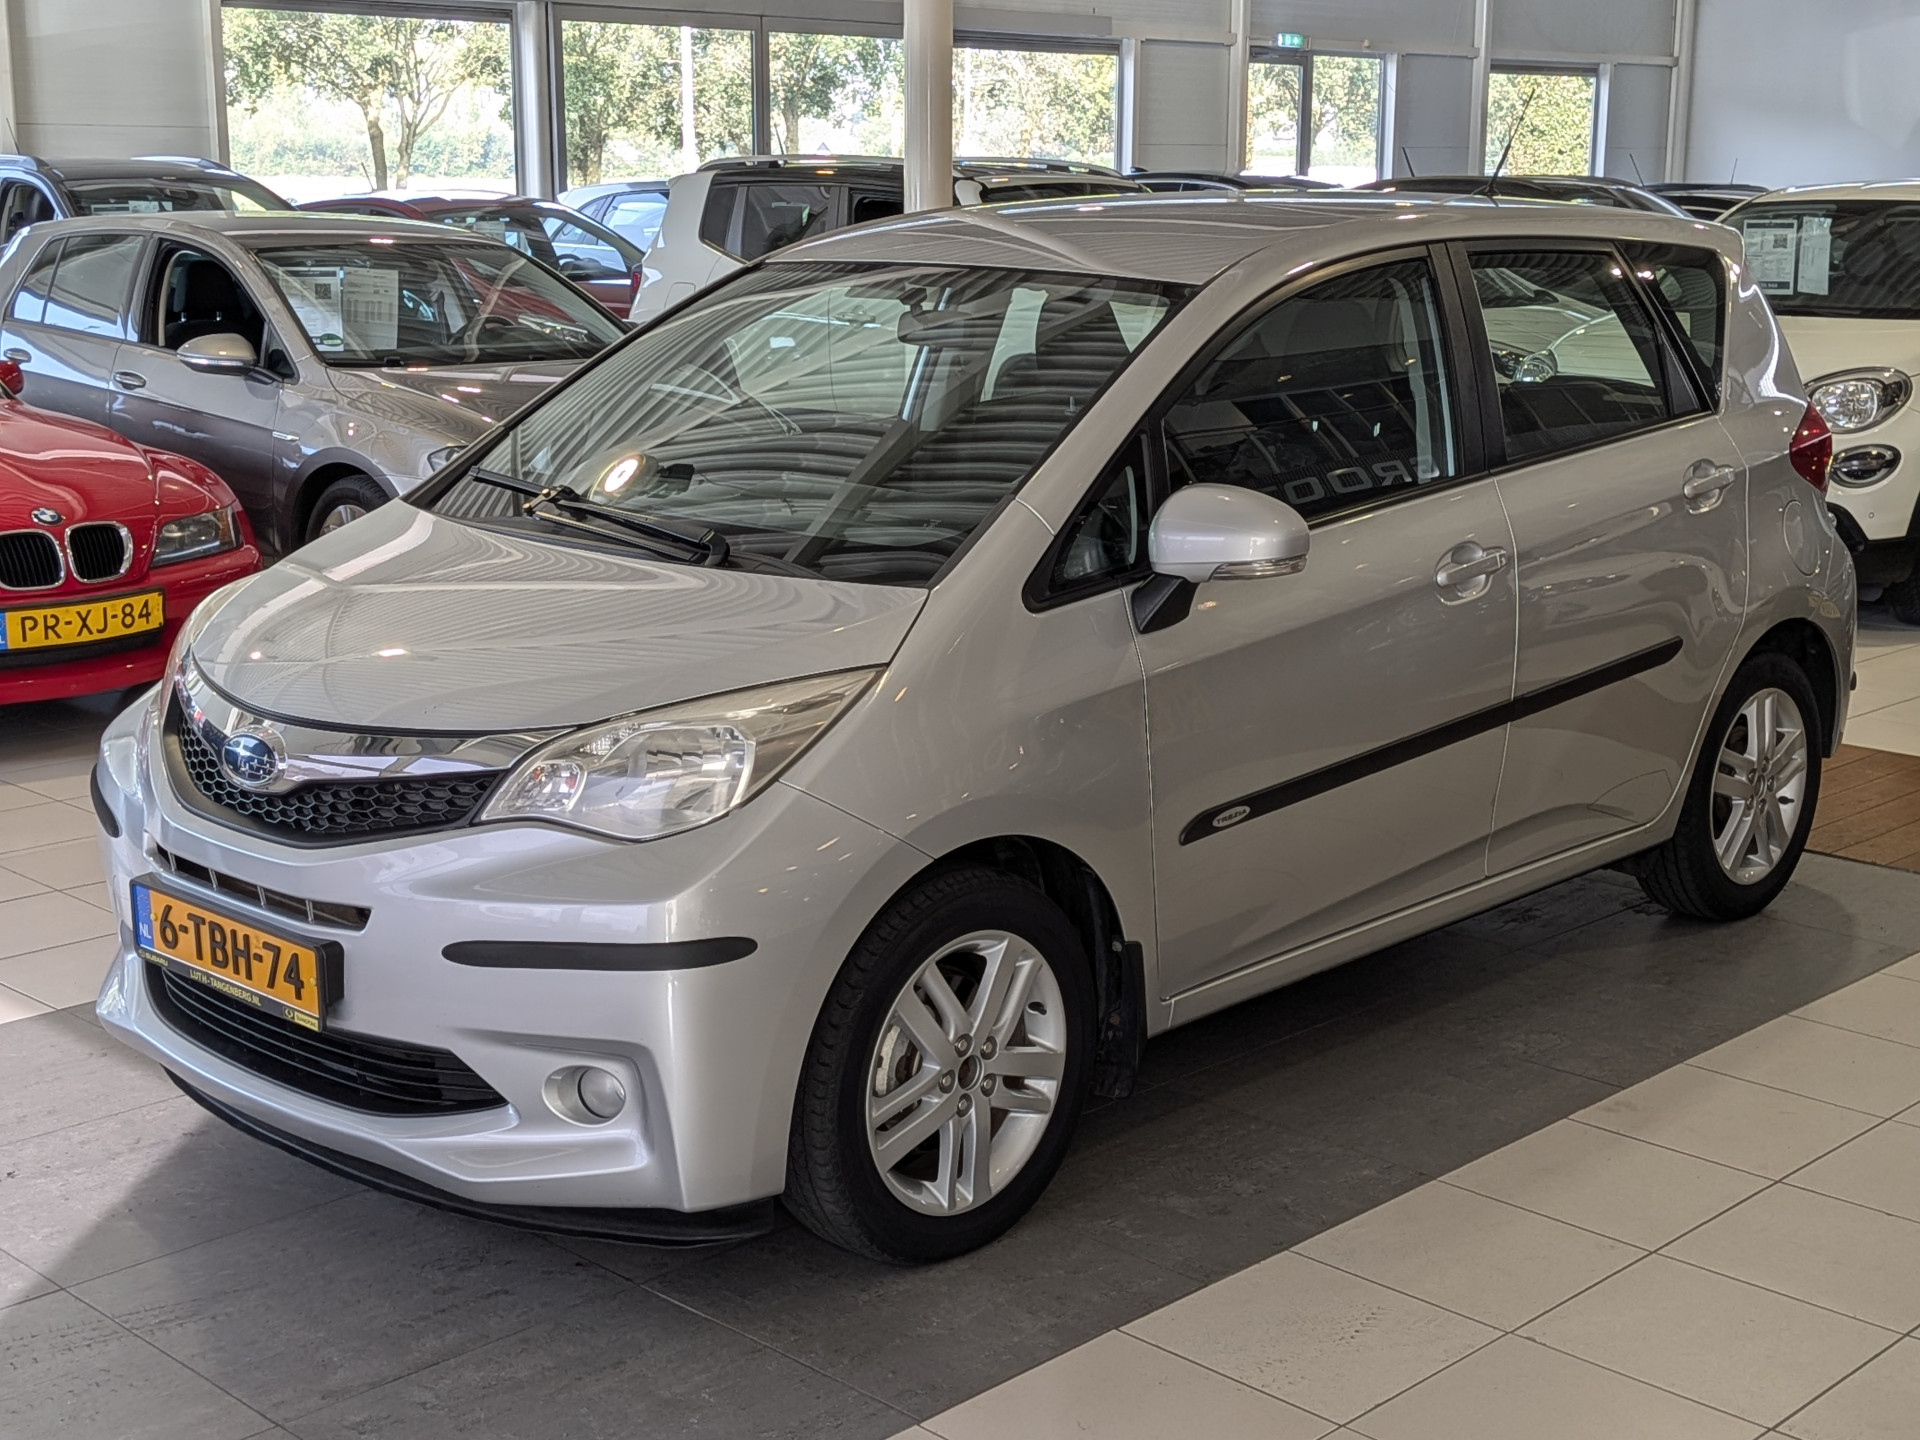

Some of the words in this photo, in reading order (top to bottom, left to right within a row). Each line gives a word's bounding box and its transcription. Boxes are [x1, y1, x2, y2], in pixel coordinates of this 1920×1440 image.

[20, 599, 152, 642] PR-XJ-84
[139, 922, 152, 939] NL
[159, 904, 305, 1001] 6-TBH-74
